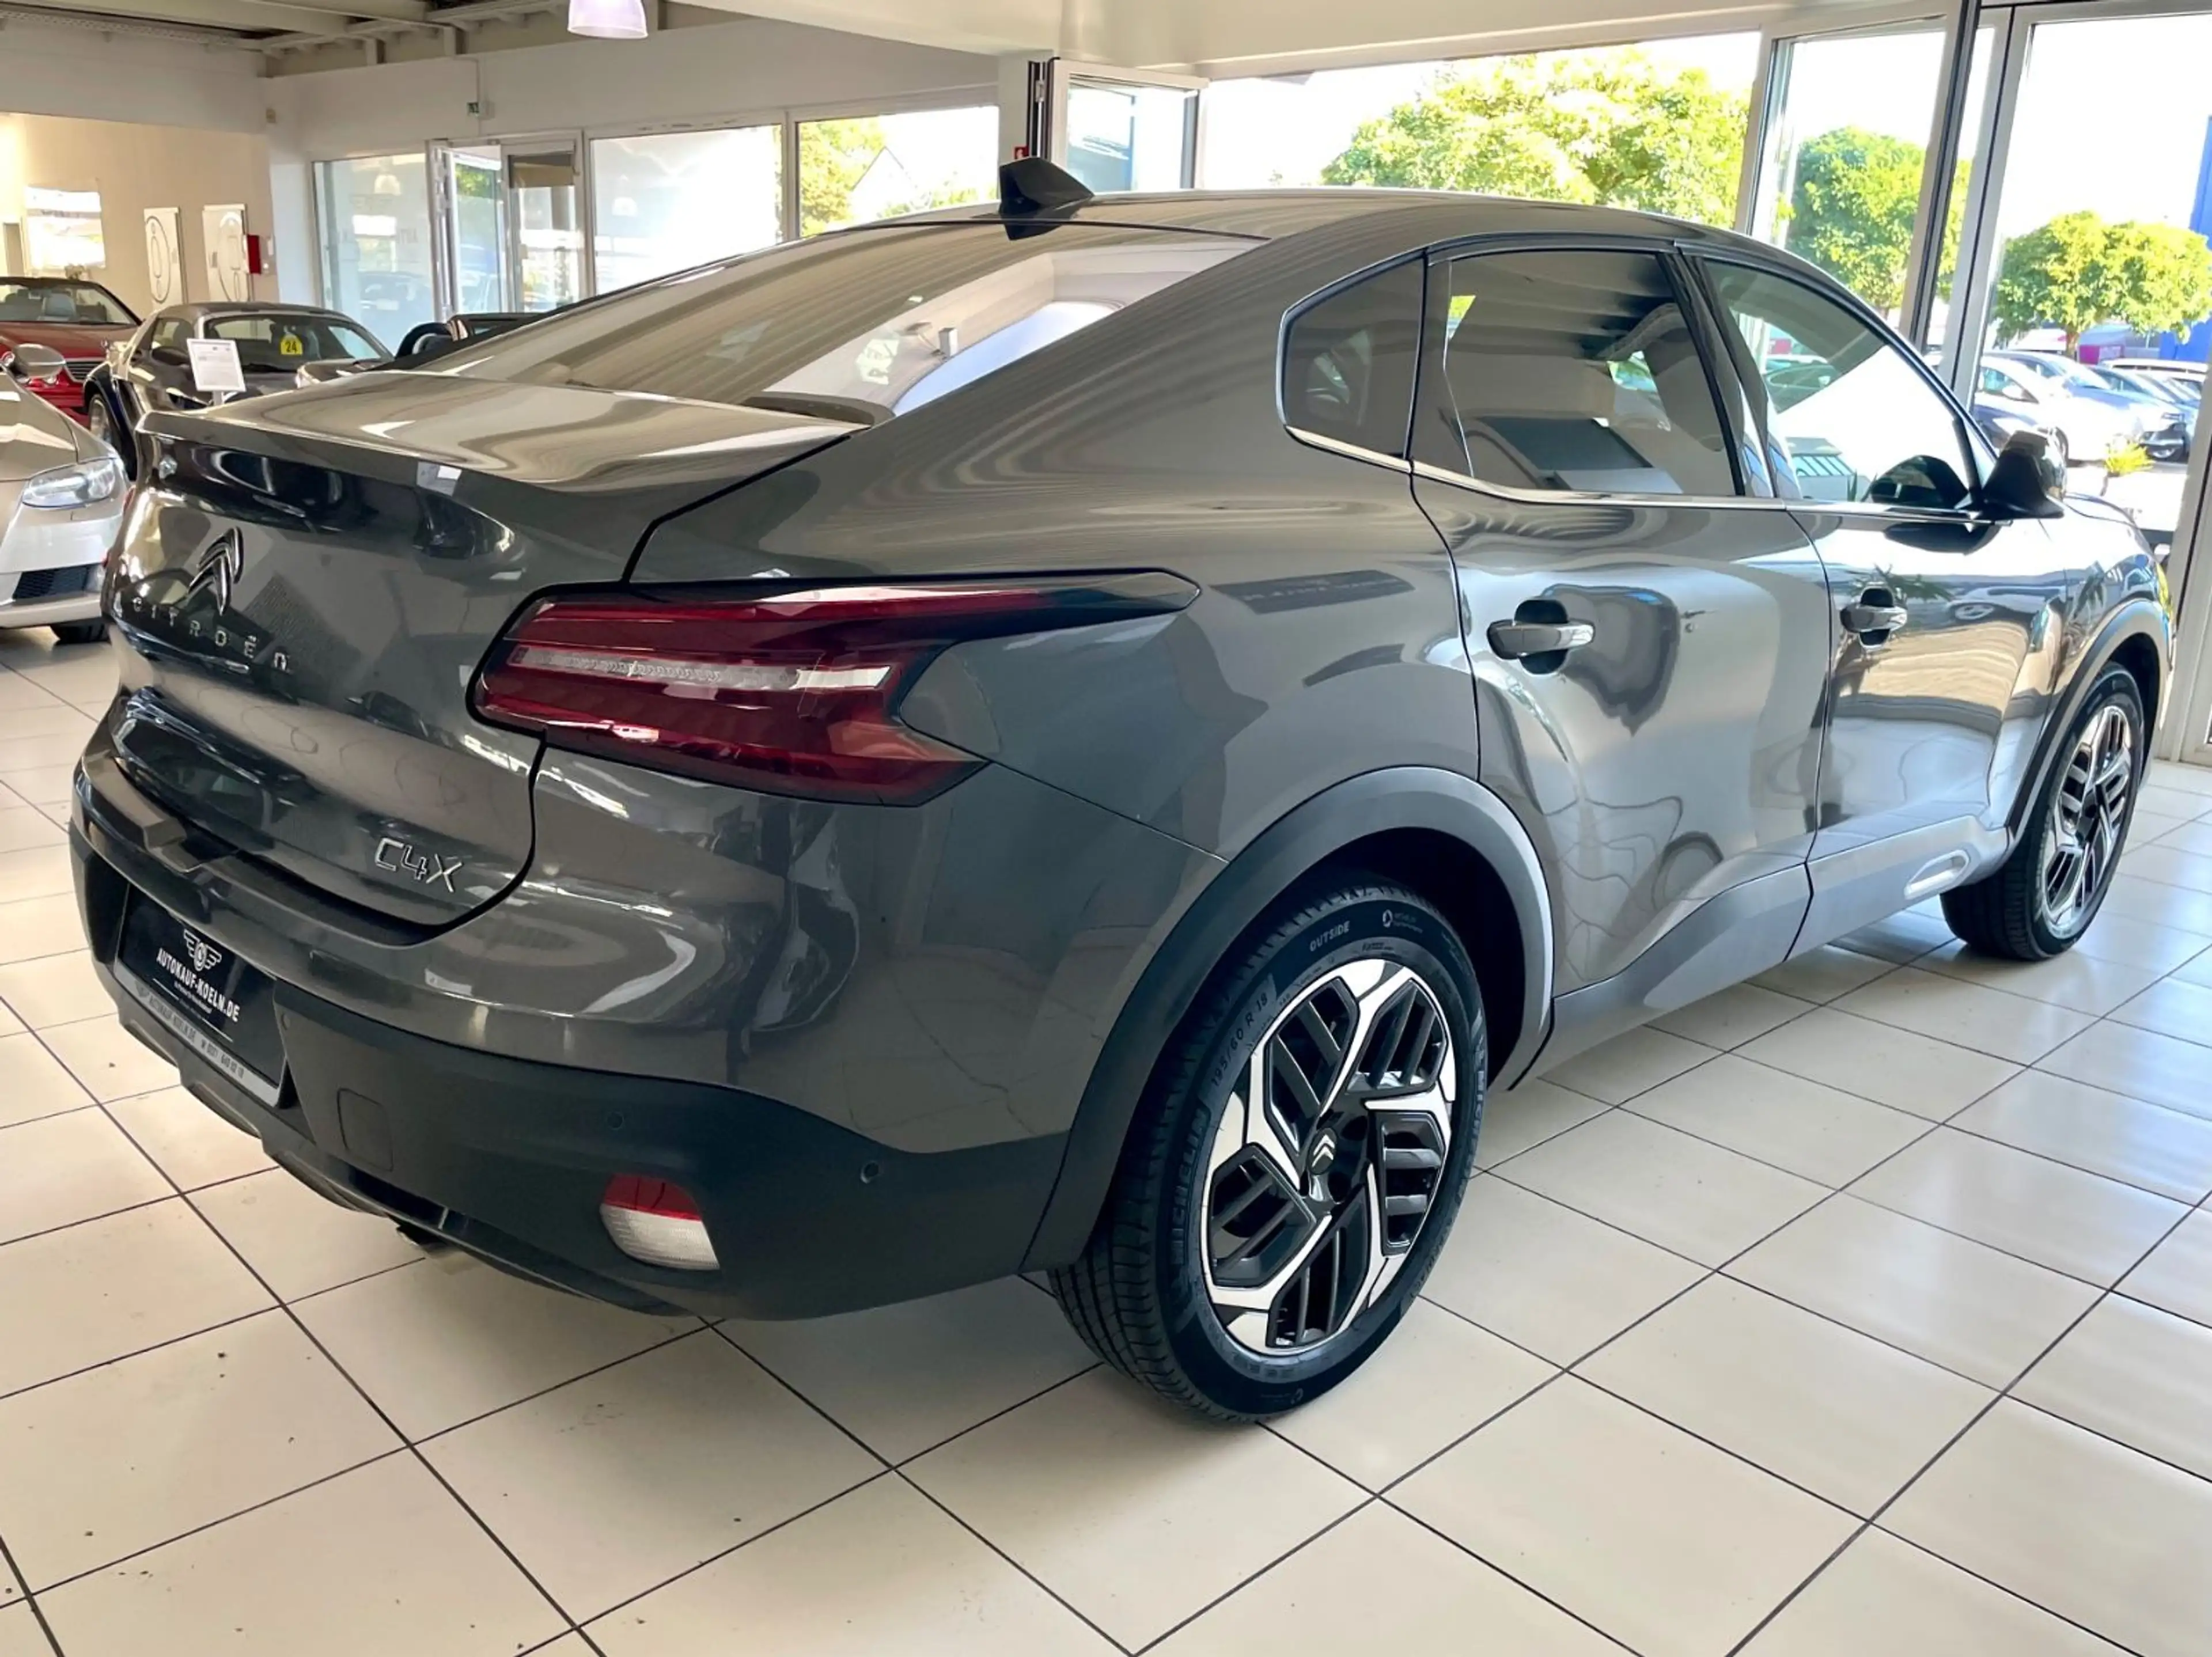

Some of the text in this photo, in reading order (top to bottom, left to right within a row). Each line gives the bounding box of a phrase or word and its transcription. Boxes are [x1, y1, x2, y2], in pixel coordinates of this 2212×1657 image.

[285, 340, 297, 354] 24
[375, 837, 462, 892] C4X
[1309, 920, 1350, 951] OUTSIDE
[156, 947, 240, 1022] AUTOKAUF-KOELN.DE
[1211, 992, 1267, 1086] 195/60 R 18
[1172, 1108, 1207, 1264] MICHELIN
